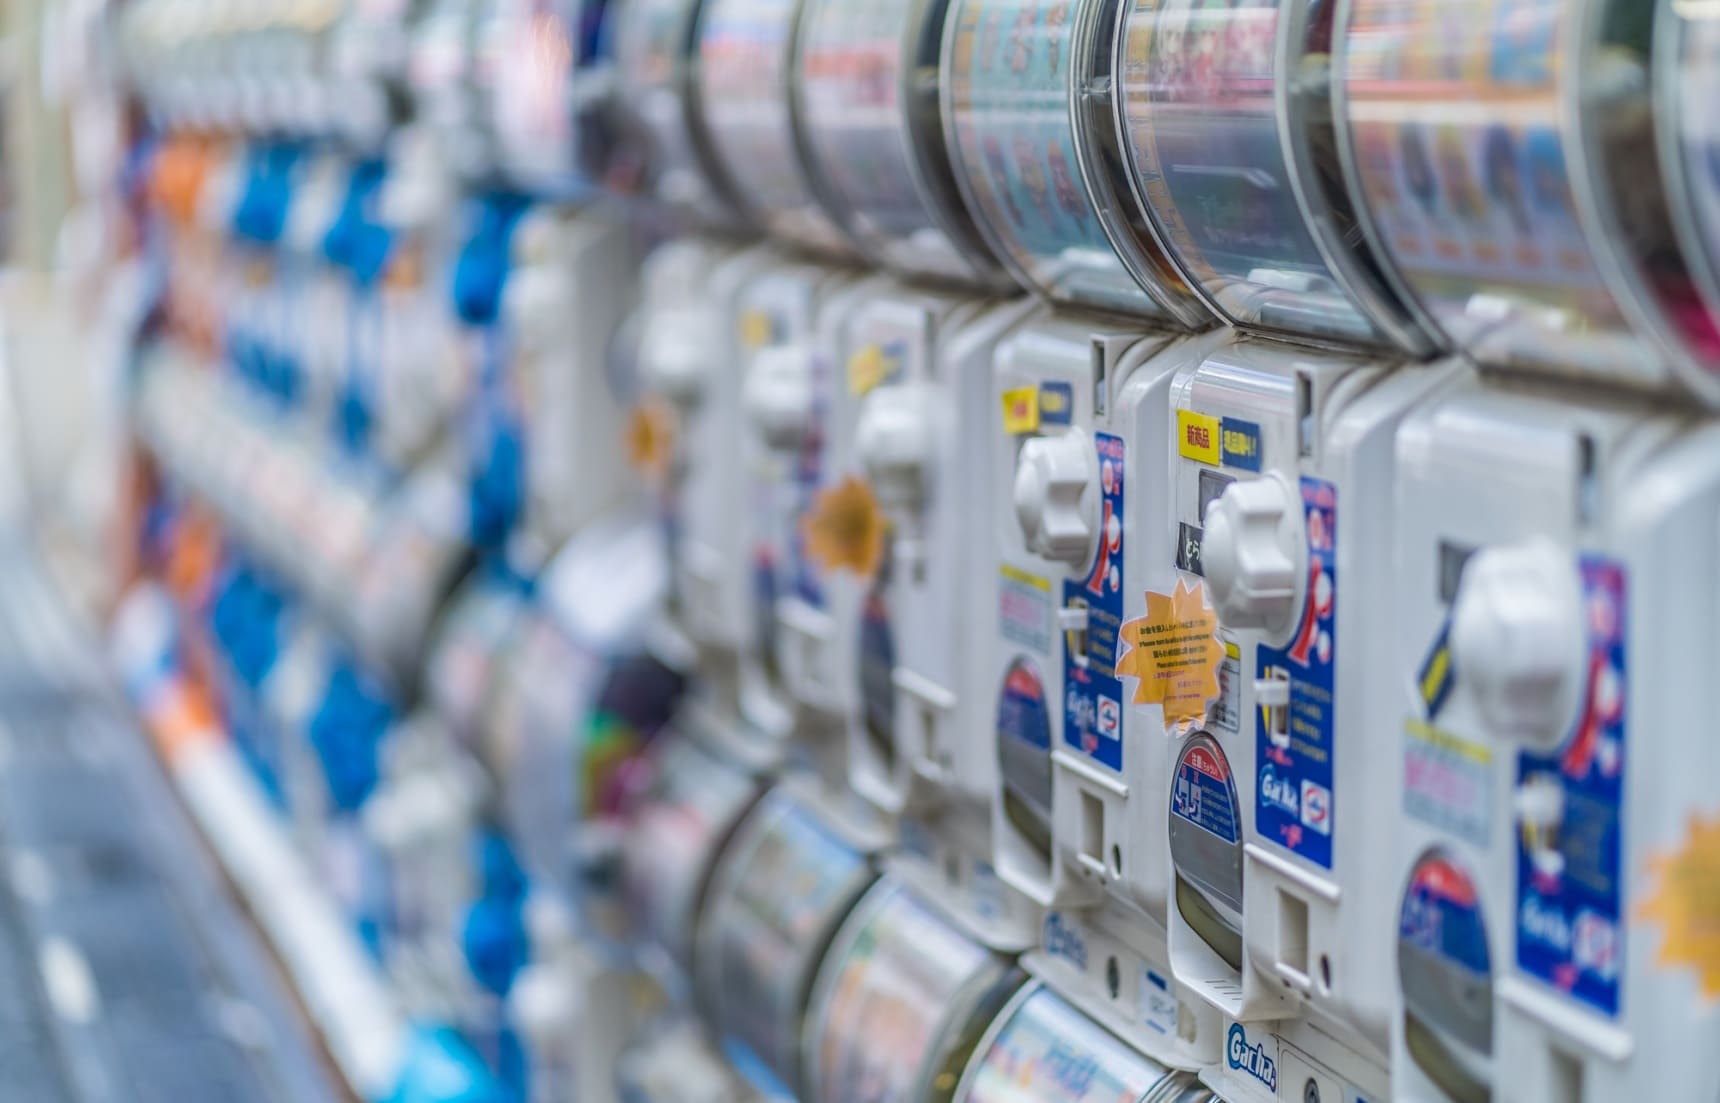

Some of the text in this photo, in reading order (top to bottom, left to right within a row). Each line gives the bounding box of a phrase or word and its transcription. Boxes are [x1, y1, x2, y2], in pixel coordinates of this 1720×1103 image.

[1187, 425, 1210, 449] 新商品
[1229, 1023, 1276, 1089] Gacha
